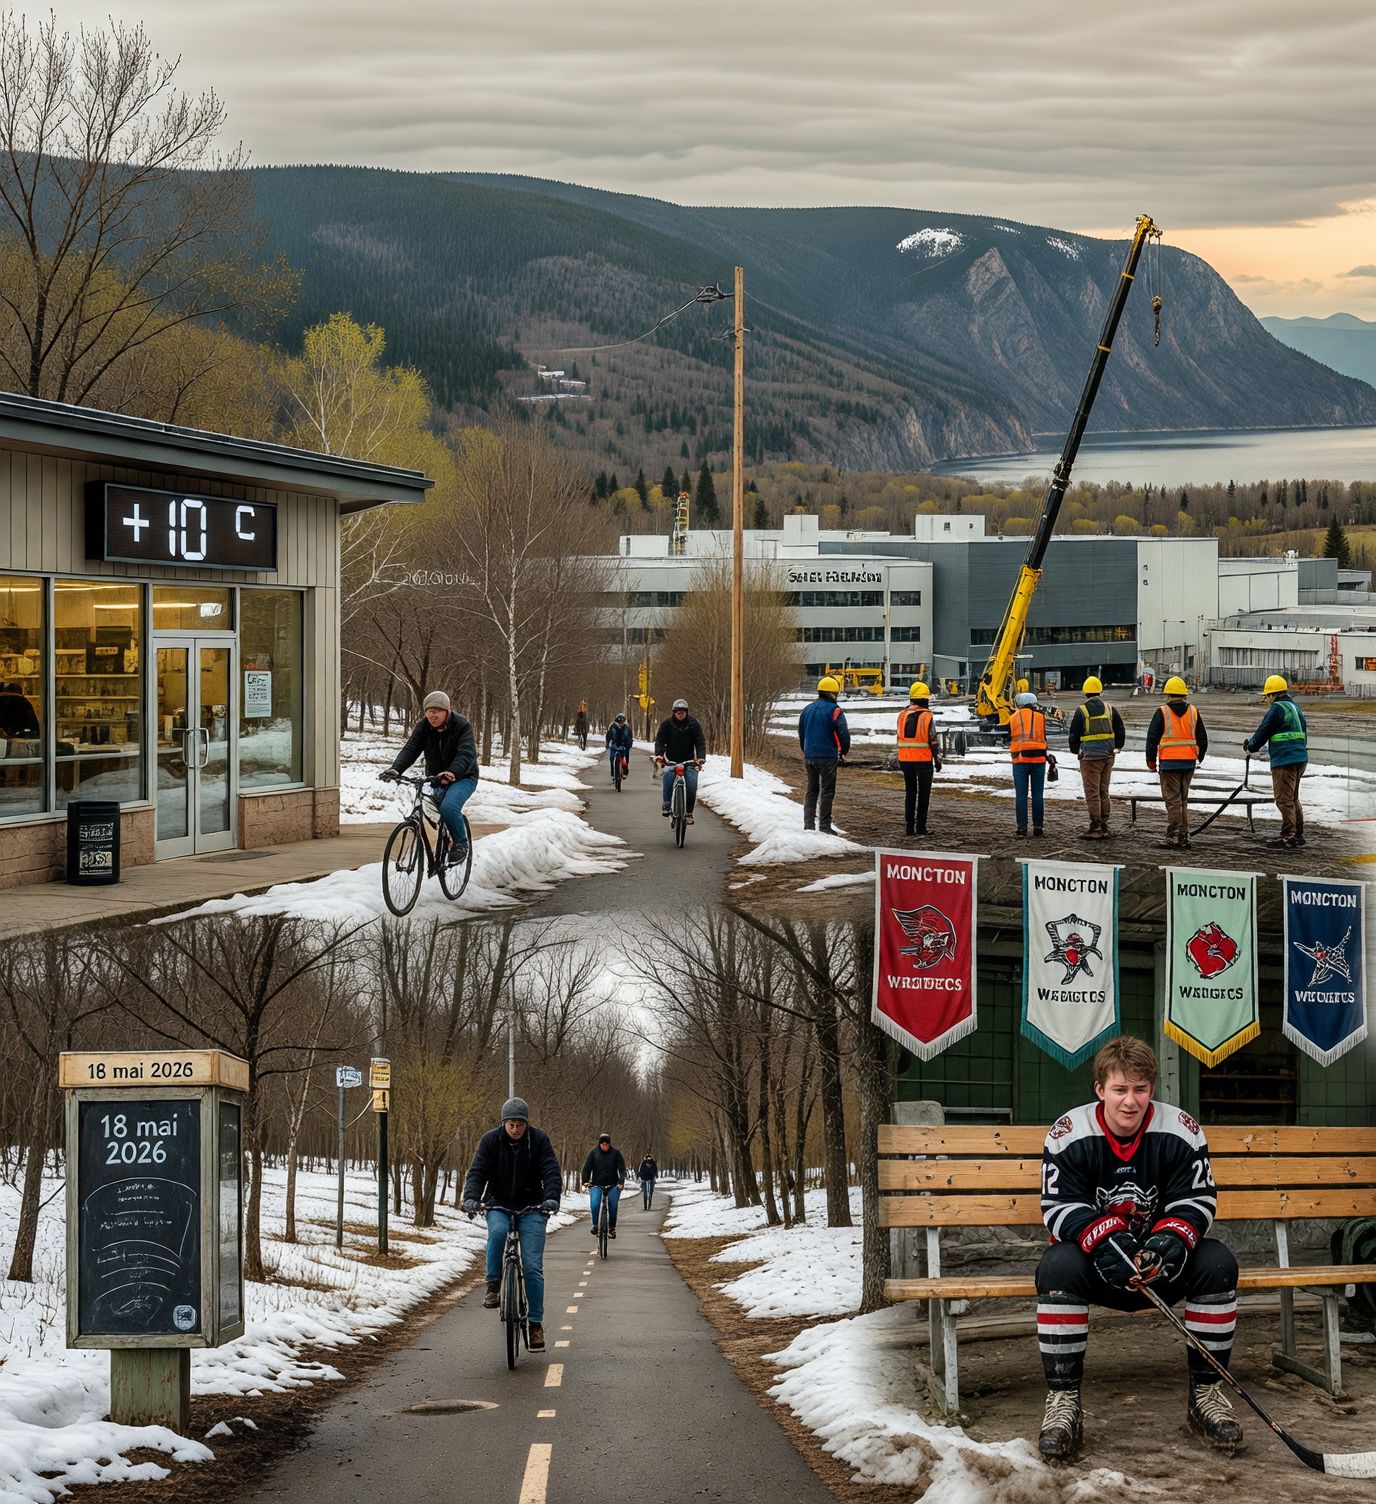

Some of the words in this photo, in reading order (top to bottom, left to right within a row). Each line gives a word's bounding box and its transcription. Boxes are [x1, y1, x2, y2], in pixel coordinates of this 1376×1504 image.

[235, 505, 256, 541] C
[886, 863, 966, 885] MONCTON
[1034, 875, 1108, 894] MONCTON
[1177, 883, 1246, 901] MONCTON
[1290, 890, 1357, 908] MONCTON
[88, 1062, 106, 1079] 18
[113, 1062, 144, 1079] mai
[150, 1061, 193, 1078] 2026
[101, 1114, 128, 1138] 18
[136, 1113, 178, 1137] mai
[105, 1140, 167, 1165] 2026
[1041, 1162, 1060, 1195] 12
